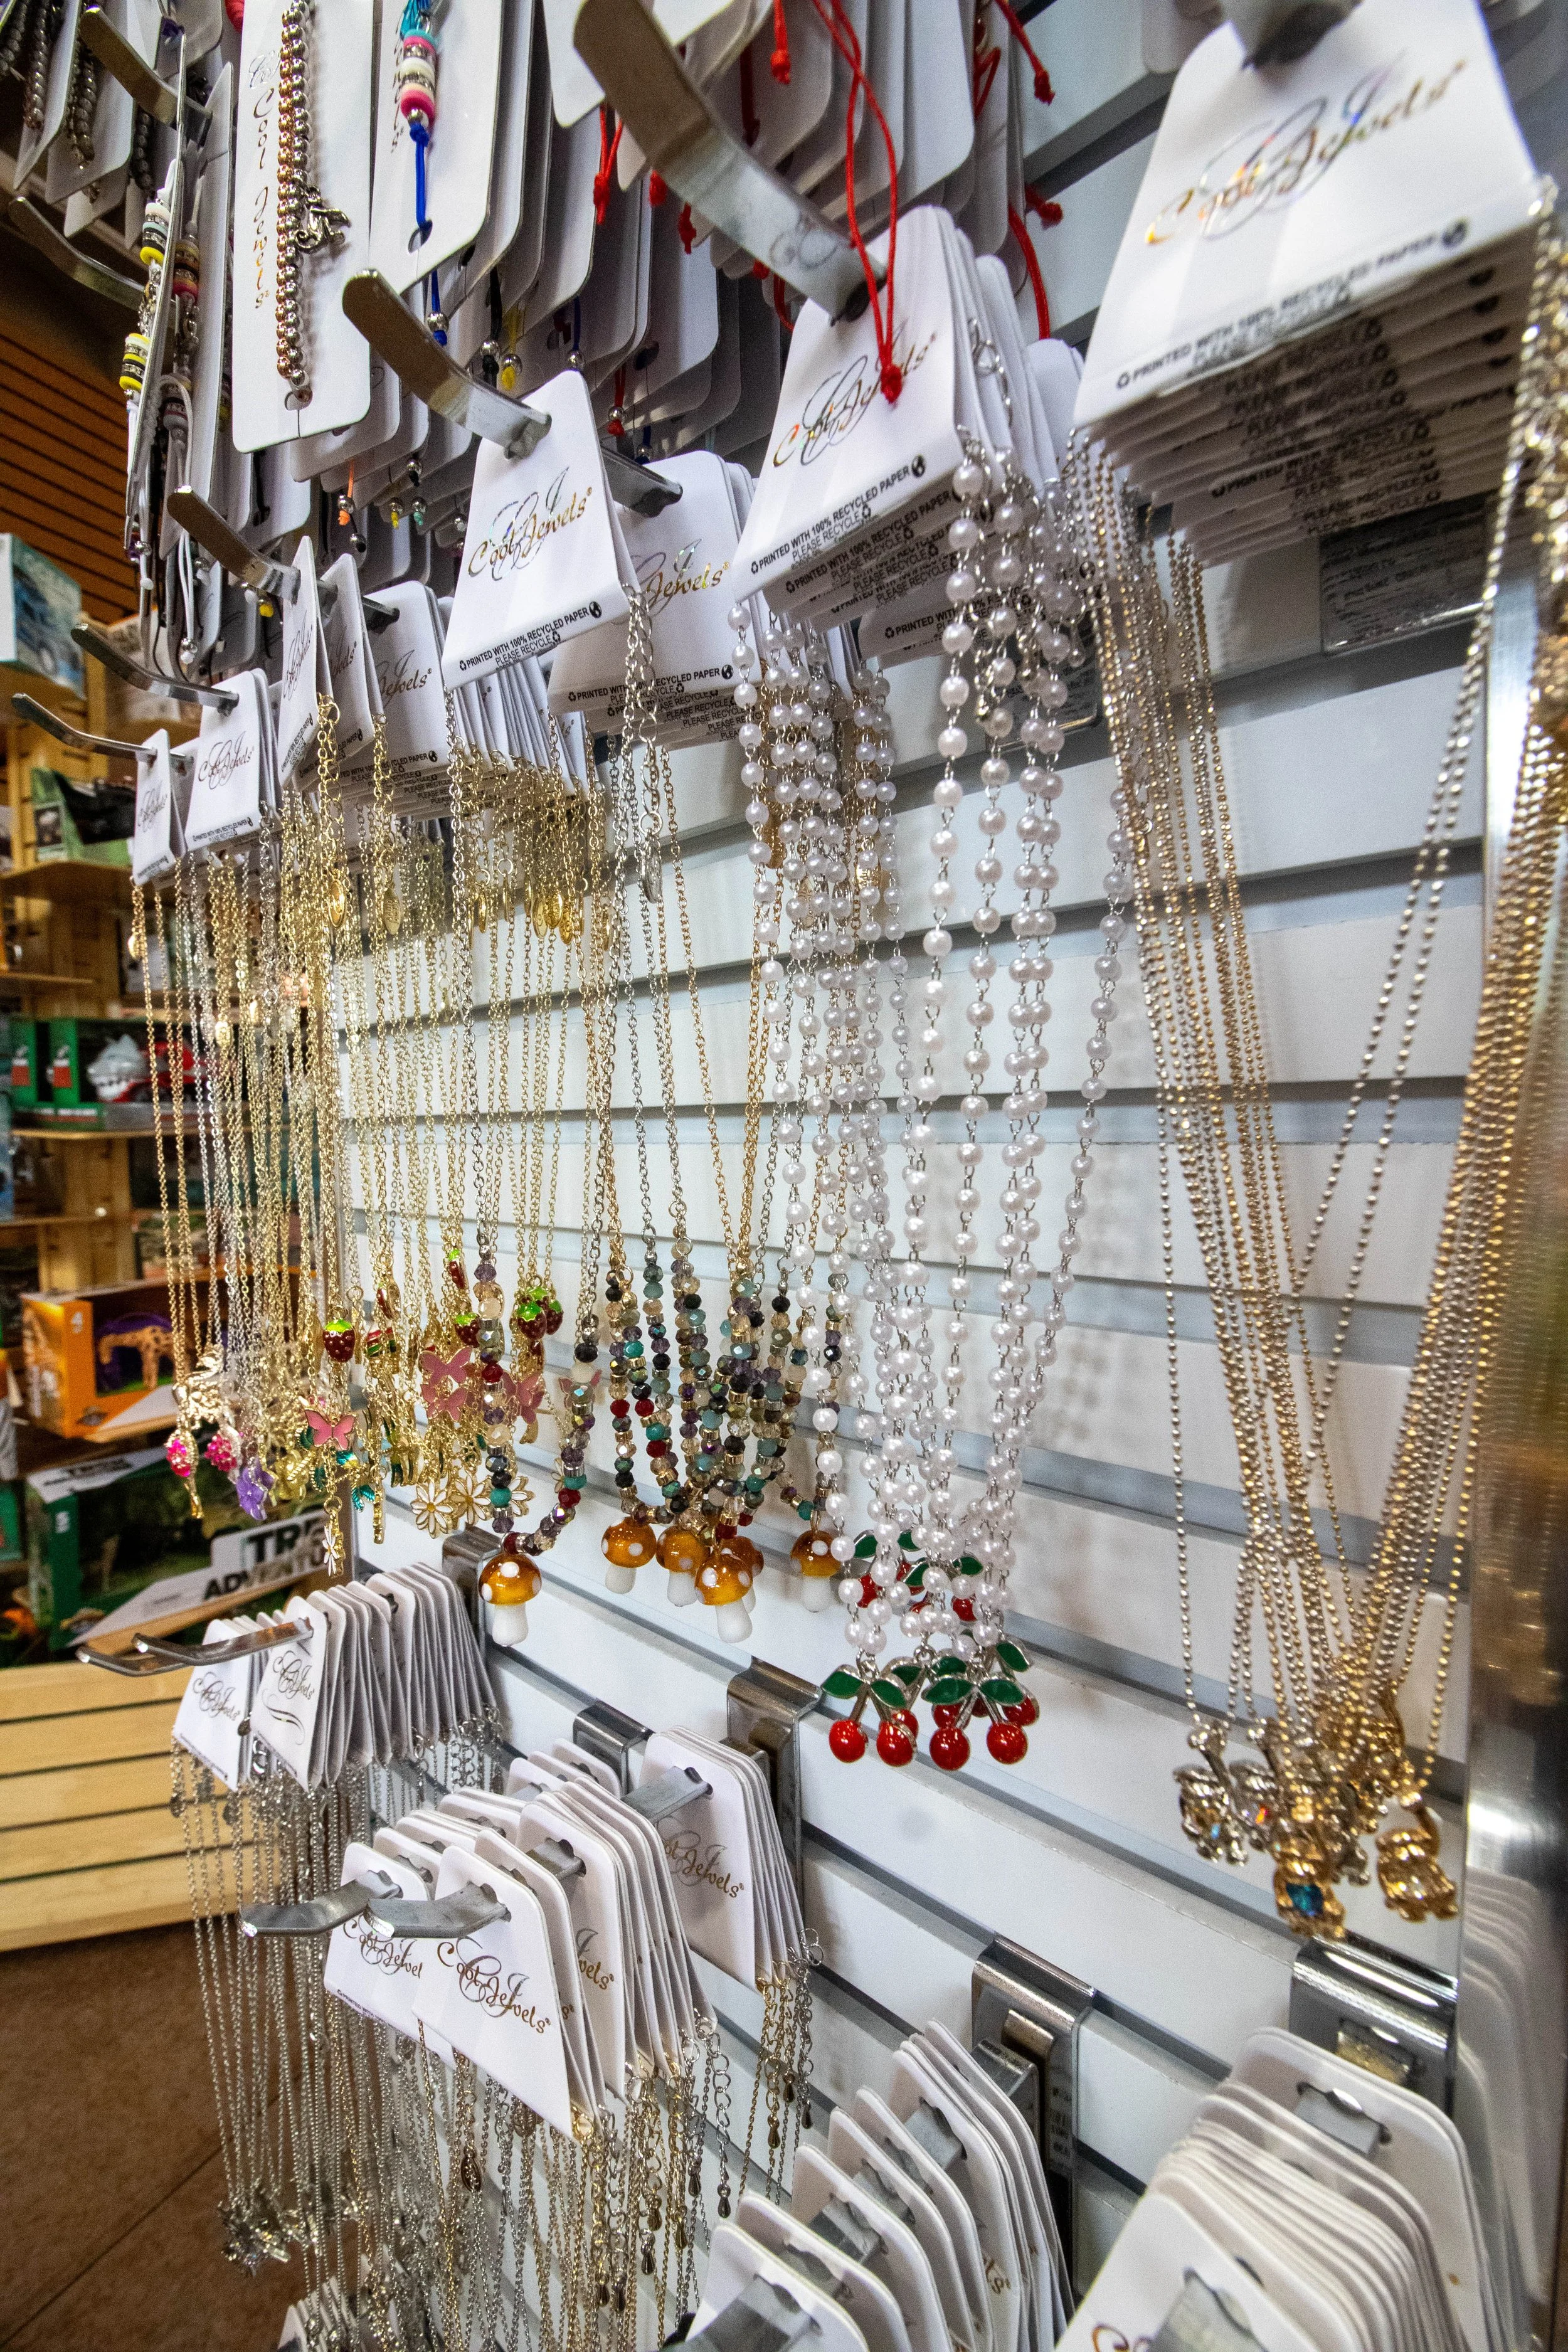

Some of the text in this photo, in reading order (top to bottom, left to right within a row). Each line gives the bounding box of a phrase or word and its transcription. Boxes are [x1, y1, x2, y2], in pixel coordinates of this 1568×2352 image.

[759, 543, 790, 569] PRINTED
[790, 531, 810, 549] WITH
[812, 517, 831, 534] 100%
[833, 486, 878, 522] RECYCLED
[879, 465, 909, 492] PAPER
[792, 537, 822, 561] PLEASE
[822, 511, 860, 542] RECYCLE
[793, 565, 827, 589] PRINTED
[828, 553, 849, 570] WITH
[849, 540, 871, 558] 100%
[871, 509, 918, 544] RECYCLED
[919, 490, 953, 516] PAPER
[831, 556, 862, 580] PLEASE
[863, 533, 903, 562] RECYCLE
[886, 548, 928, 576] RECYCLE
[466, 650, 493, 669] PRINTED
[492, 642, 509, 656] WITH
[511, 635, 527, 649] 100%
[527, 618, 564, 643] RECYCLED
[564, 607, 590, 625] PAPER
[896, 616, 934, 635] PRINTED
[495, 649, 521, 665] PLEASE
[521, 635, 551, 655] RECYCLE
[577, 687, 608, 700] PRINTED
[693, 664, 720, 680] PAPER
[666, 704, 693, 718] PLEASE
[694, 698, 730, 712] RECYCLE
[675, 692, 708, 705] RECYCLE
[682, 714, 710, 727] PLEASE
[708, 719, 734, 731] PLEASE
[409, 753, 428, 763] PAPER
[437, 1941, 480, 1986] Cool
